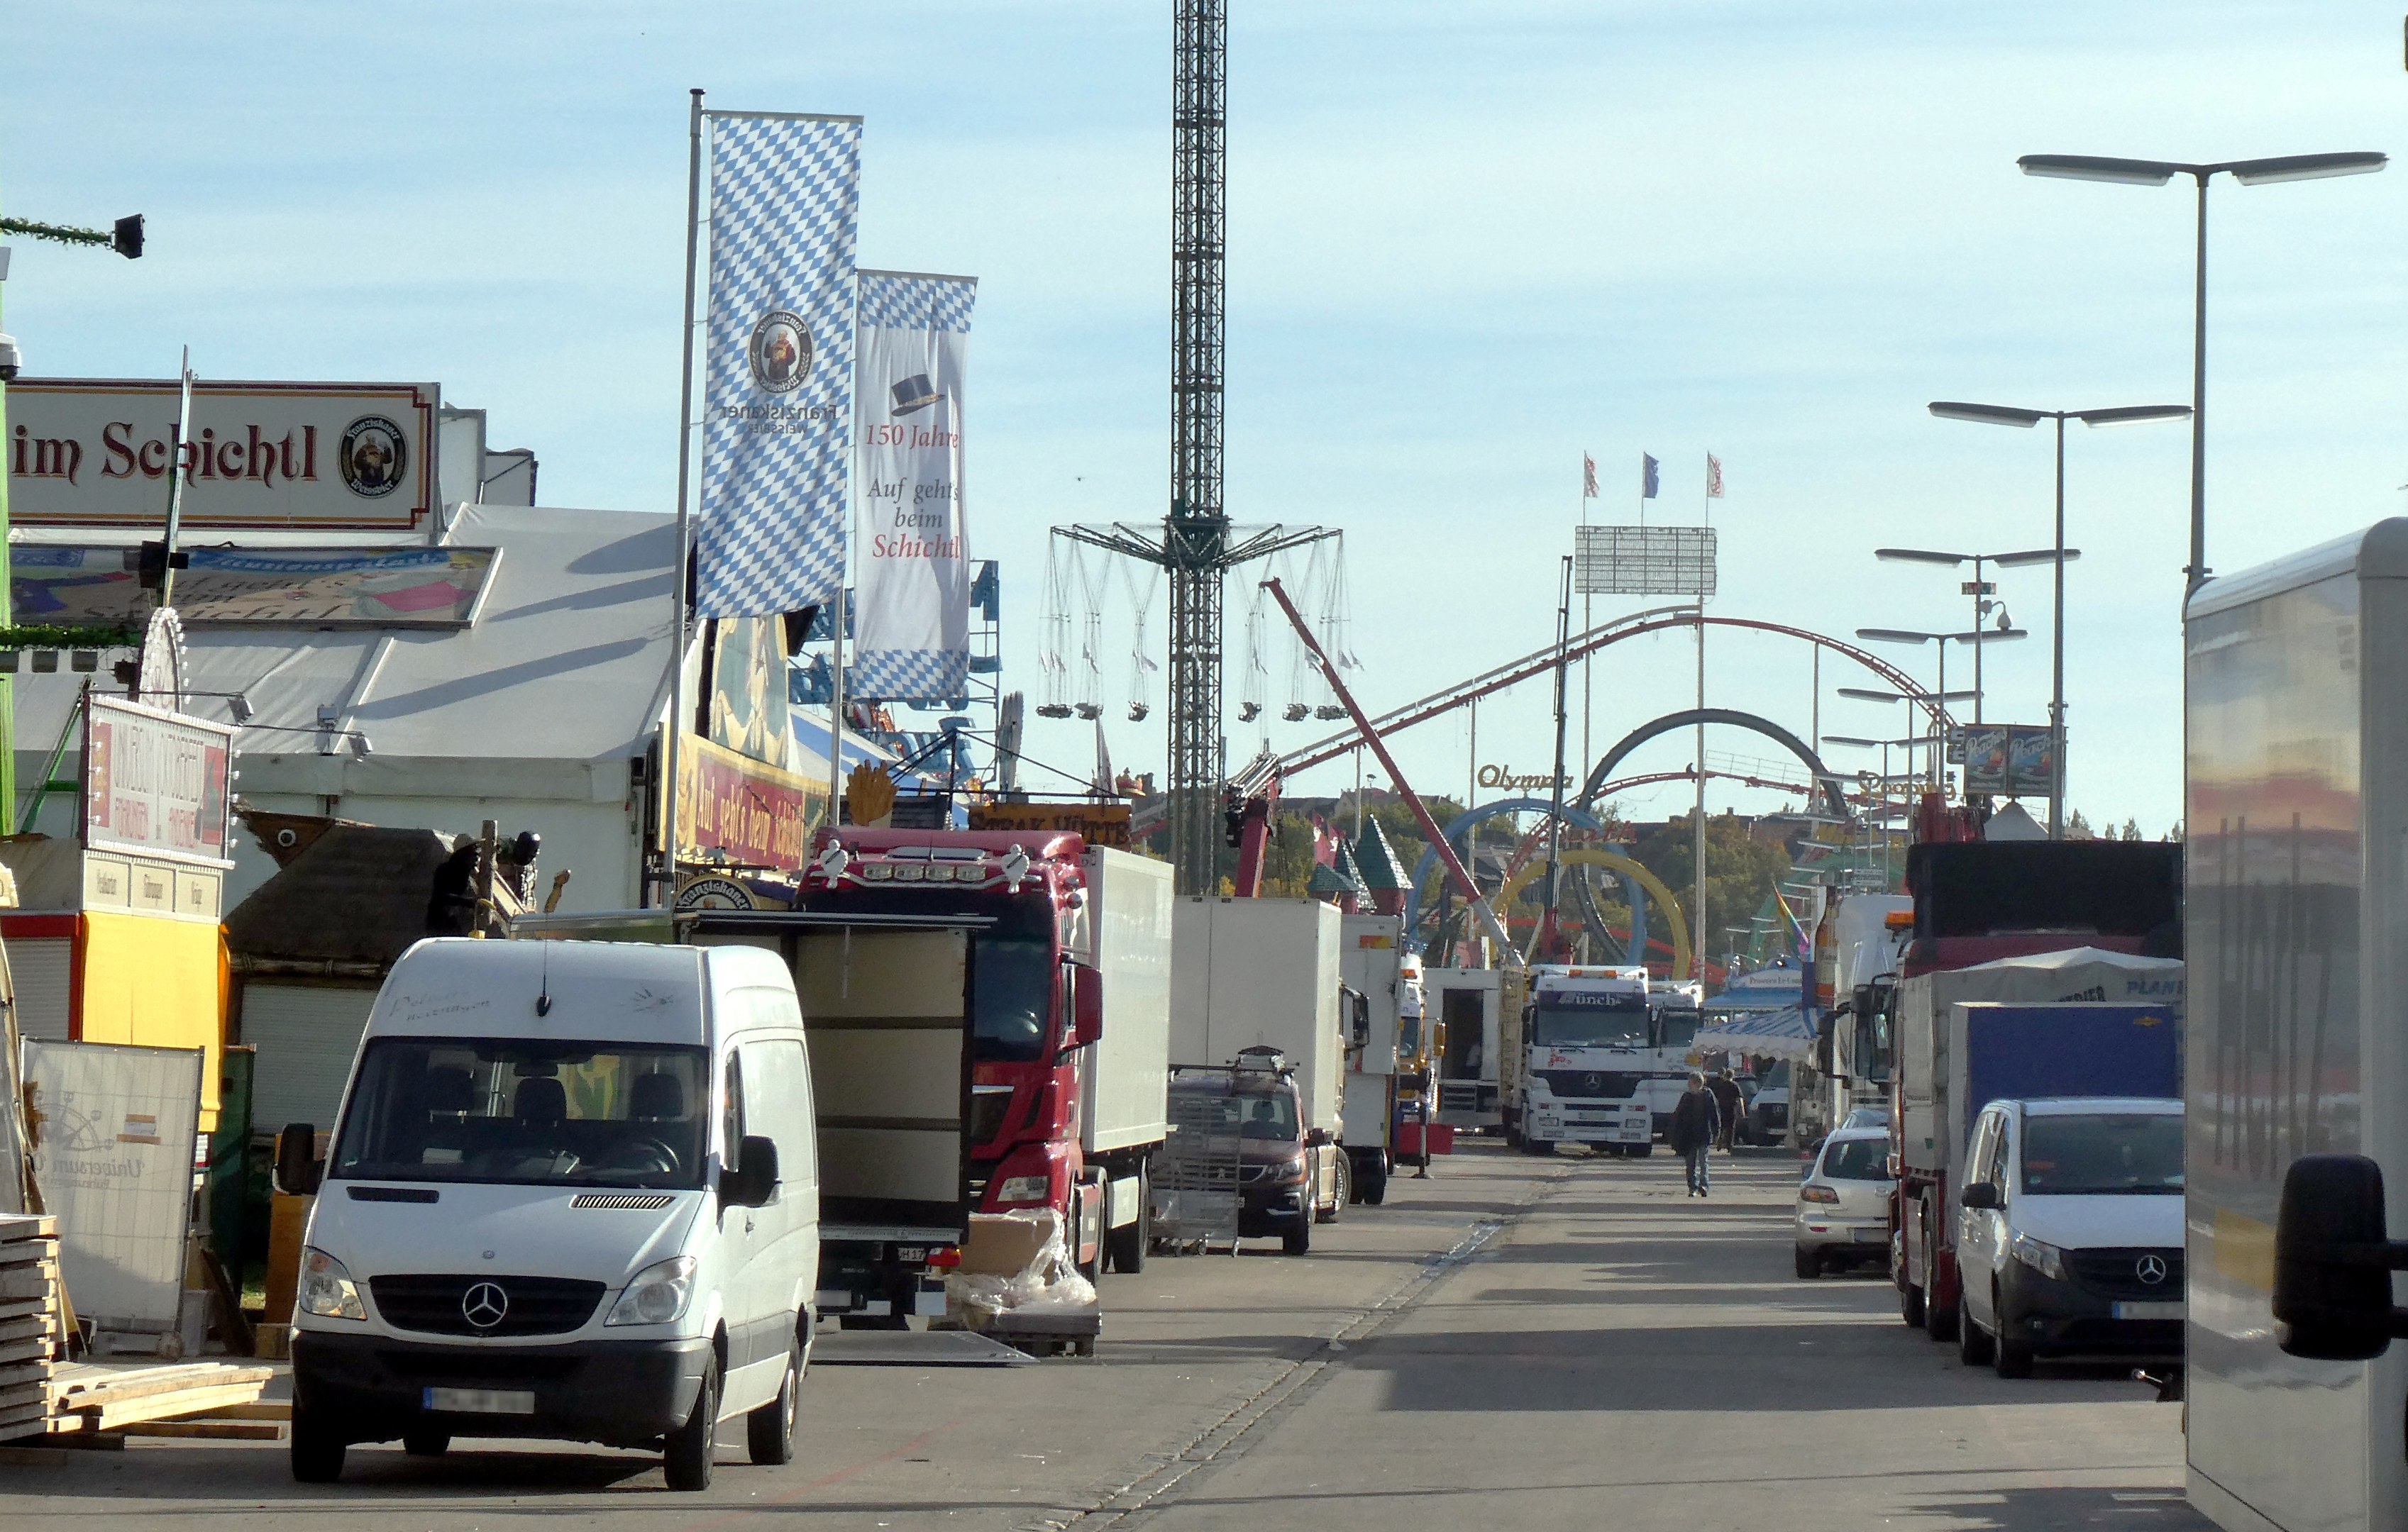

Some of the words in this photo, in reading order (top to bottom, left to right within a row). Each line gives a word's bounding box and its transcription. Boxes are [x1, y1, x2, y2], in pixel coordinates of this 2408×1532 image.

[866, 424, 905, 445] 150
[909, 424, 959, 450] Jahre
[101, 422, 319, 489] Schichtl
[867, 477, 907, 504] Auf
[895, 506, 942, 528] beim
[872, 533, 960, 559] Schichtl
[1477, 765, 1574, 792] Olympa
[697, 768, 715, 833] Auf
[747, 794, 771, 858] beim
